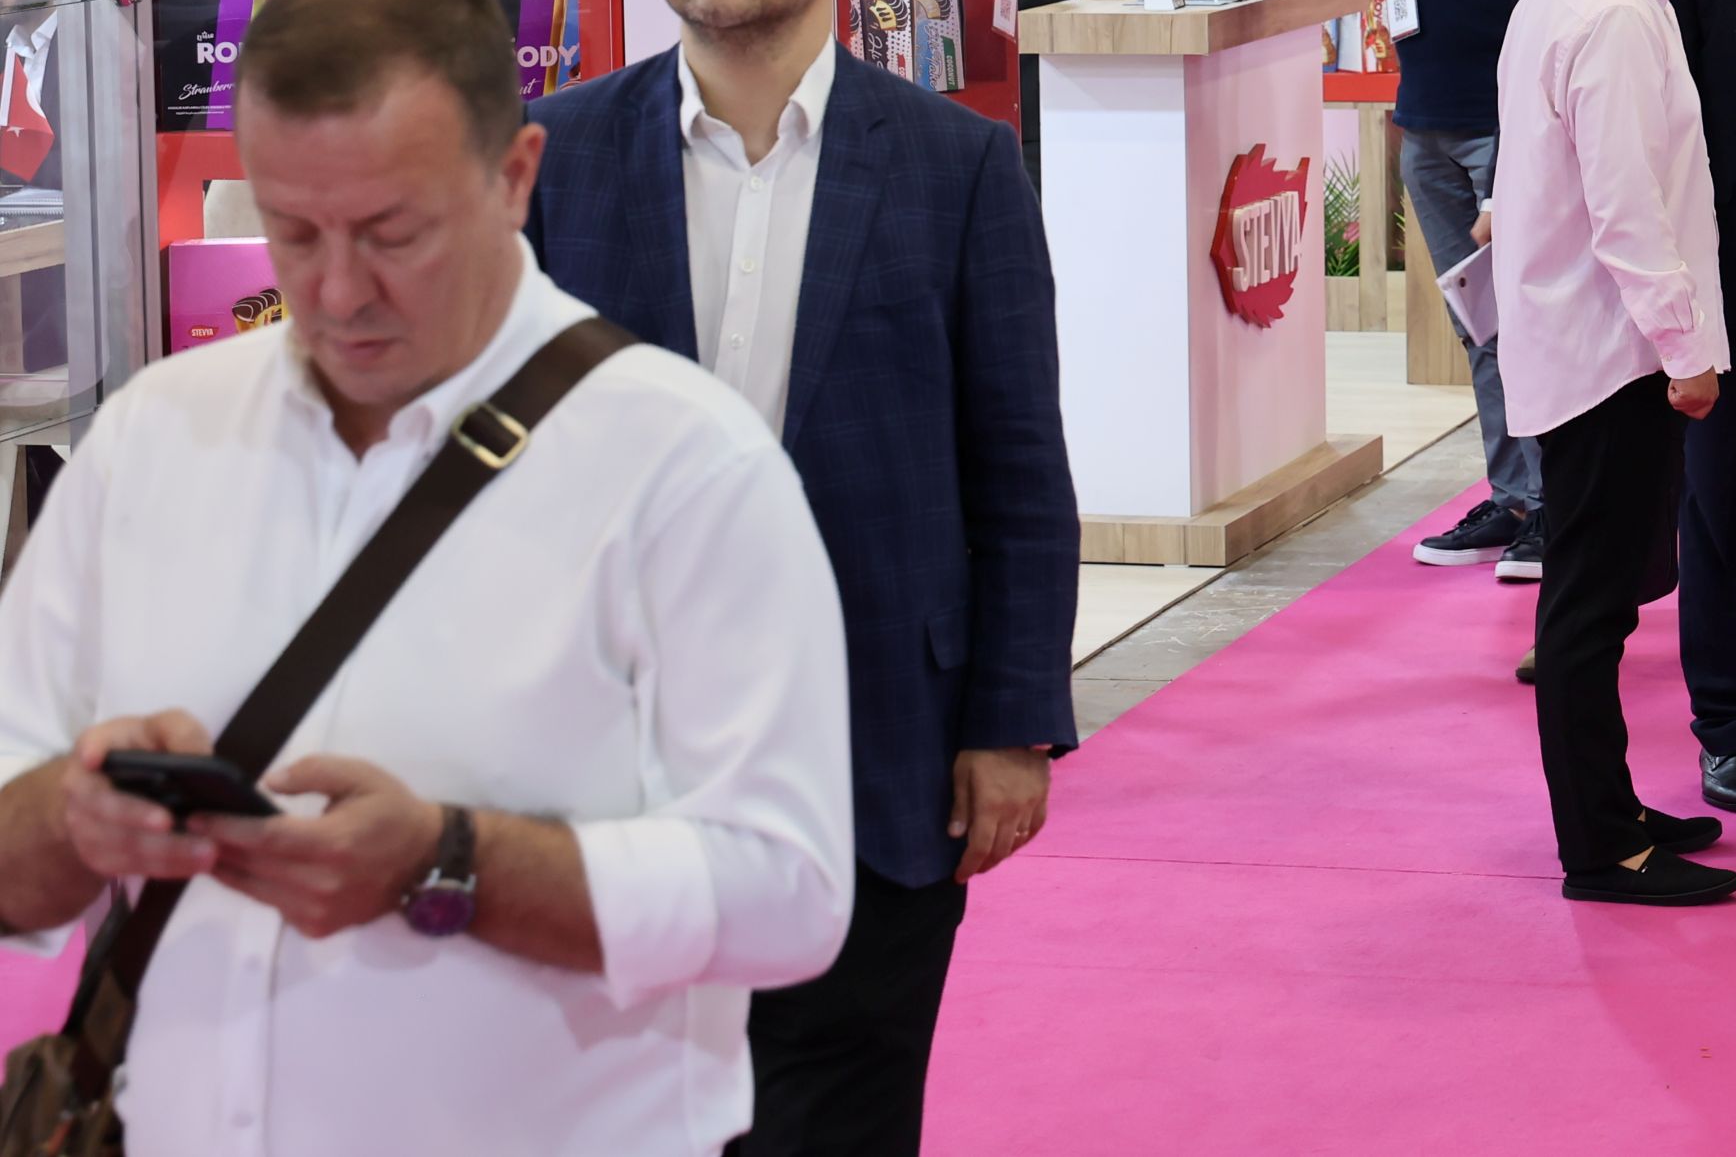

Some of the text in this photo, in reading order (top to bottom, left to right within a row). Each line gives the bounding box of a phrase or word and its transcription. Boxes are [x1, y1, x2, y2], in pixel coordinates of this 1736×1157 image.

[196, 41, 238, 64] RO
[517, 45, 578, 68] ODY
[946, 55, 956, 86] COCONUT
[1232, 190, 1301, 293] STEVYA
